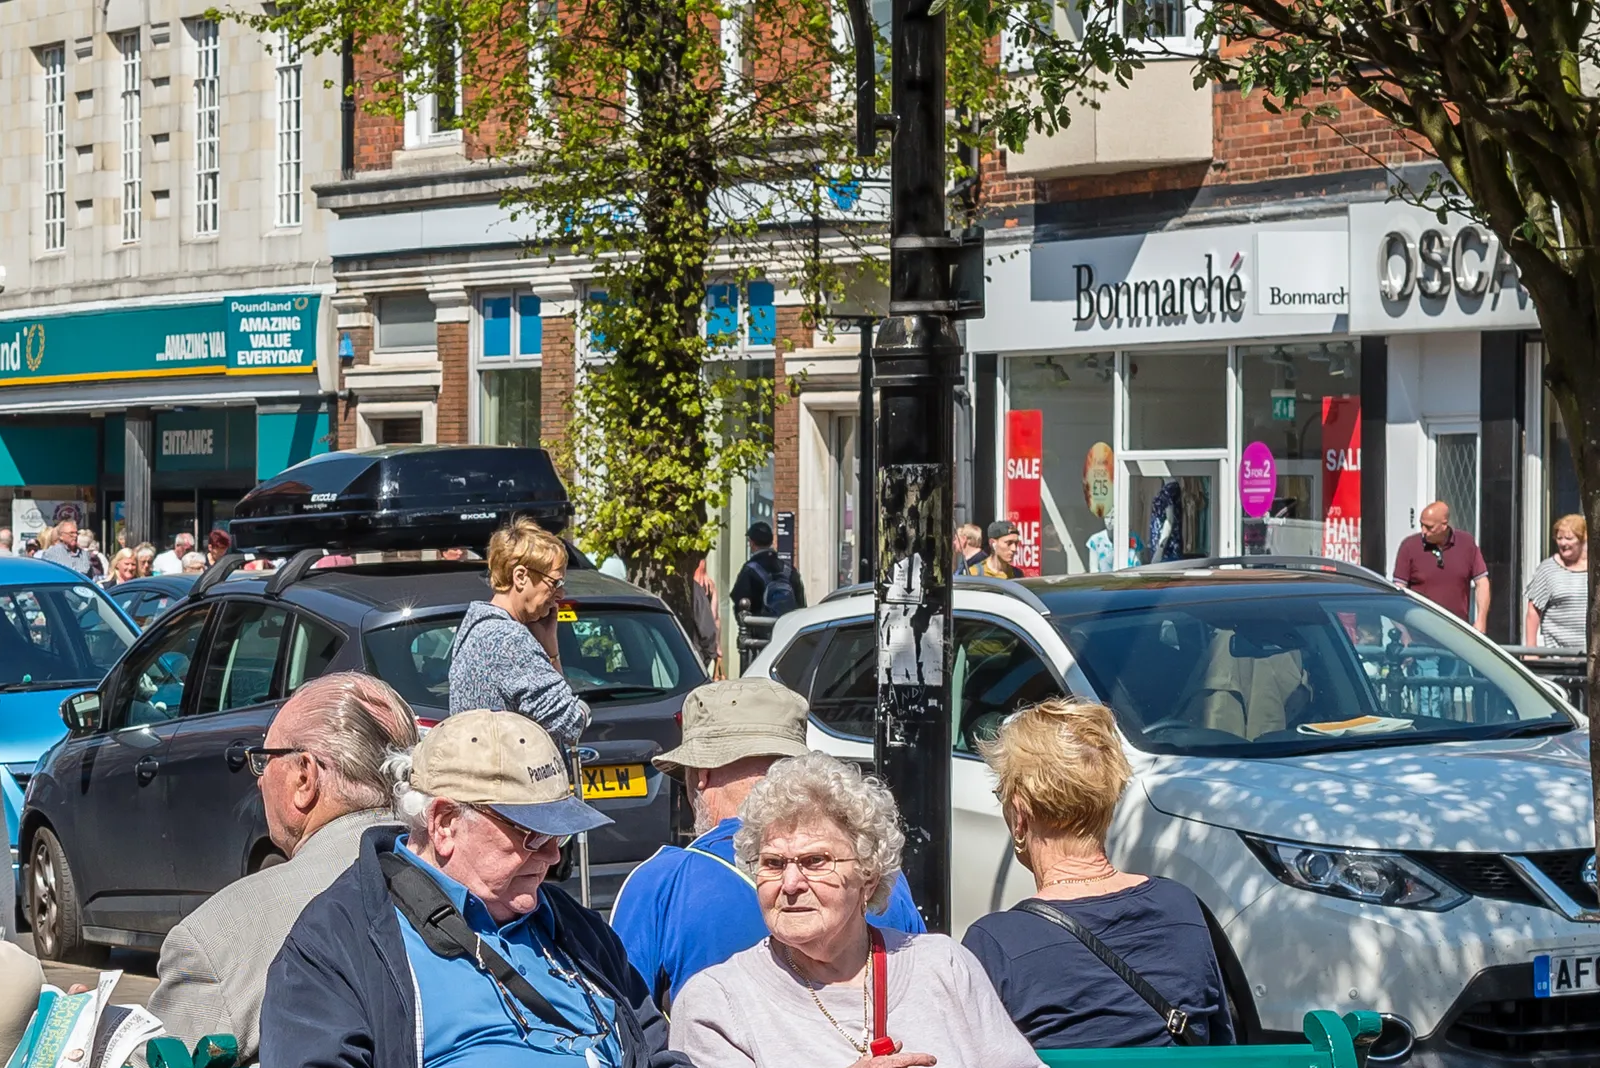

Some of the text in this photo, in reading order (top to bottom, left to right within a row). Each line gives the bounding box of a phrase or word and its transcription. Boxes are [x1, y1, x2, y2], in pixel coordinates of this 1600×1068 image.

[1072, 252, 1244, 321] Bonmarché
[229, 300, 292, 313] Poundland
[239, 316, 301, 332] AMAZING
[249, 332, 292, 349] VALUE
[236, 349, 304, 366] EVERYDAY
[162, 429, 214, 456] ENTRANCE
[1007, 458, 1041, 480] SALE
[1243, 461, 1251, 479] 3
[1263, 460, 1271, 478] 2
[584, 768, 630, 792] XLW
[1555, 956, 1600, 990] AF
